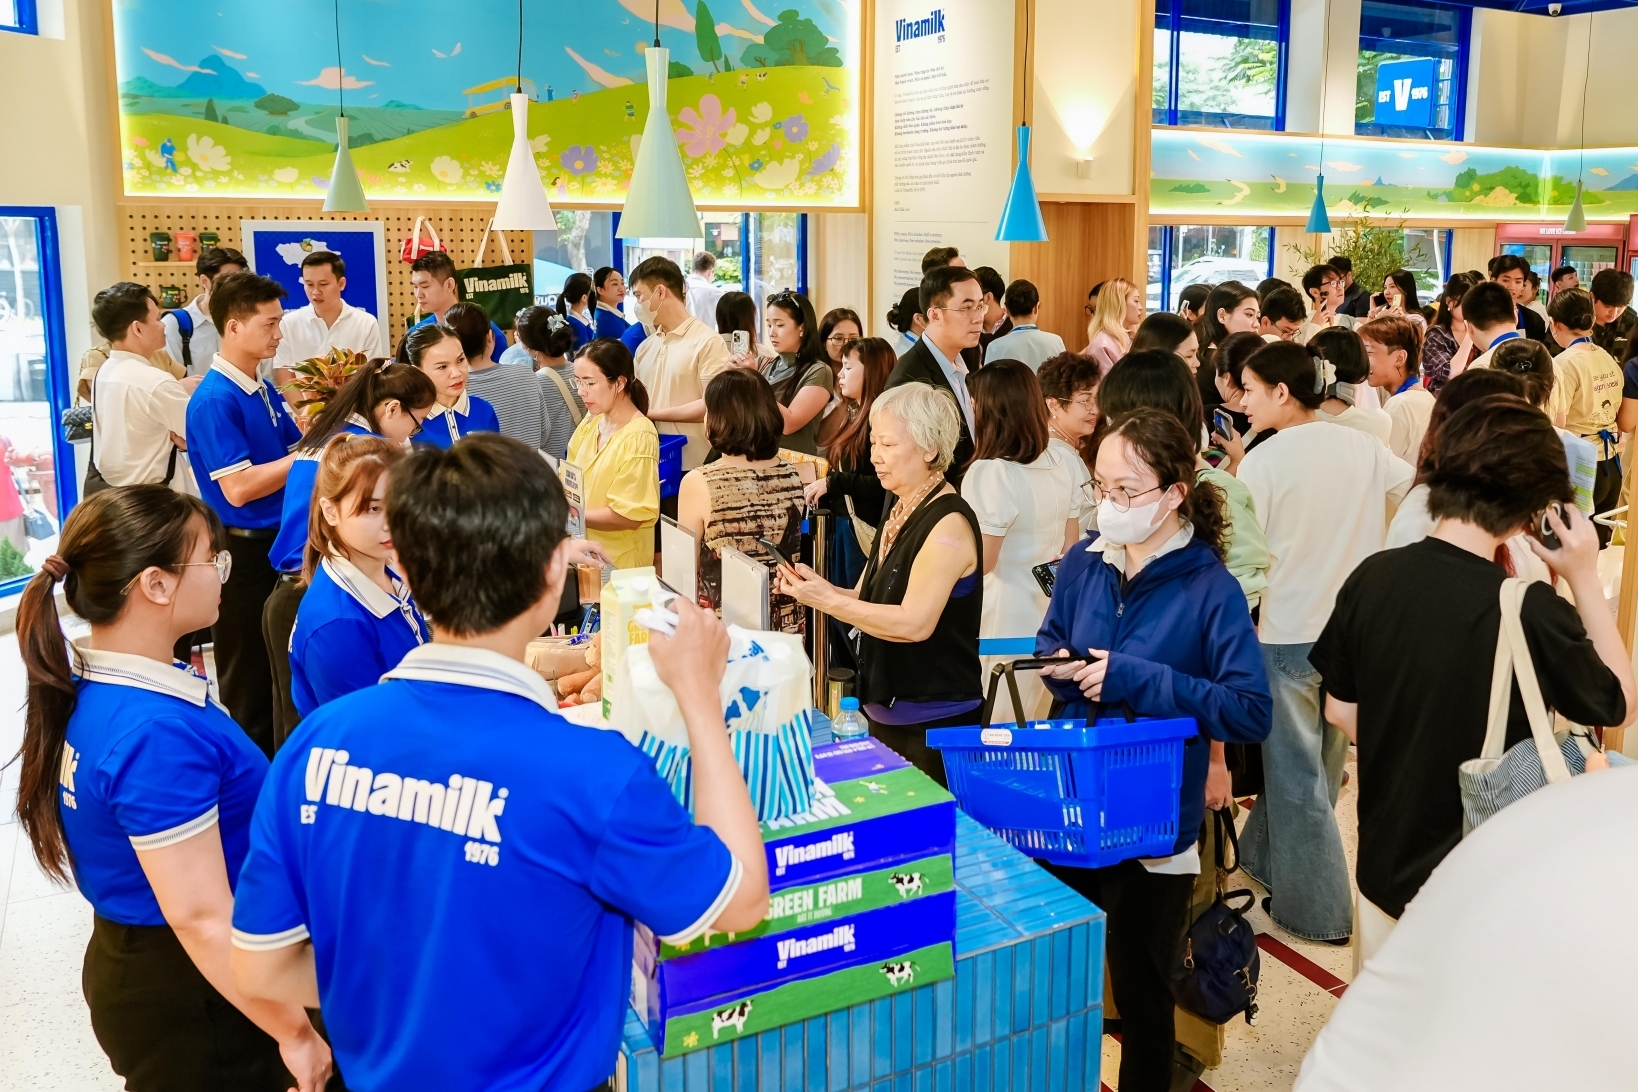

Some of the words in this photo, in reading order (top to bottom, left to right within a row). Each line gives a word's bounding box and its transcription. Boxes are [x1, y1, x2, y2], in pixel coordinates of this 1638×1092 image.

[895, 9, 944, 42] Vinamilk
[1378, 90, 1391, 103] EST
[1393, 77, 1412, 111] V
[1411, 86, 1429, 100] 1976
[464, 272, 528, 292] Vinamilk
[304, 747, 509, 843] Vinamilk
[464, 840, 500, 867] 1976
[775, 830, 855, 867] Vinamilk
[818, 877, 863, 908] FARM
[777, 924, 856, 960] Vinamilk
